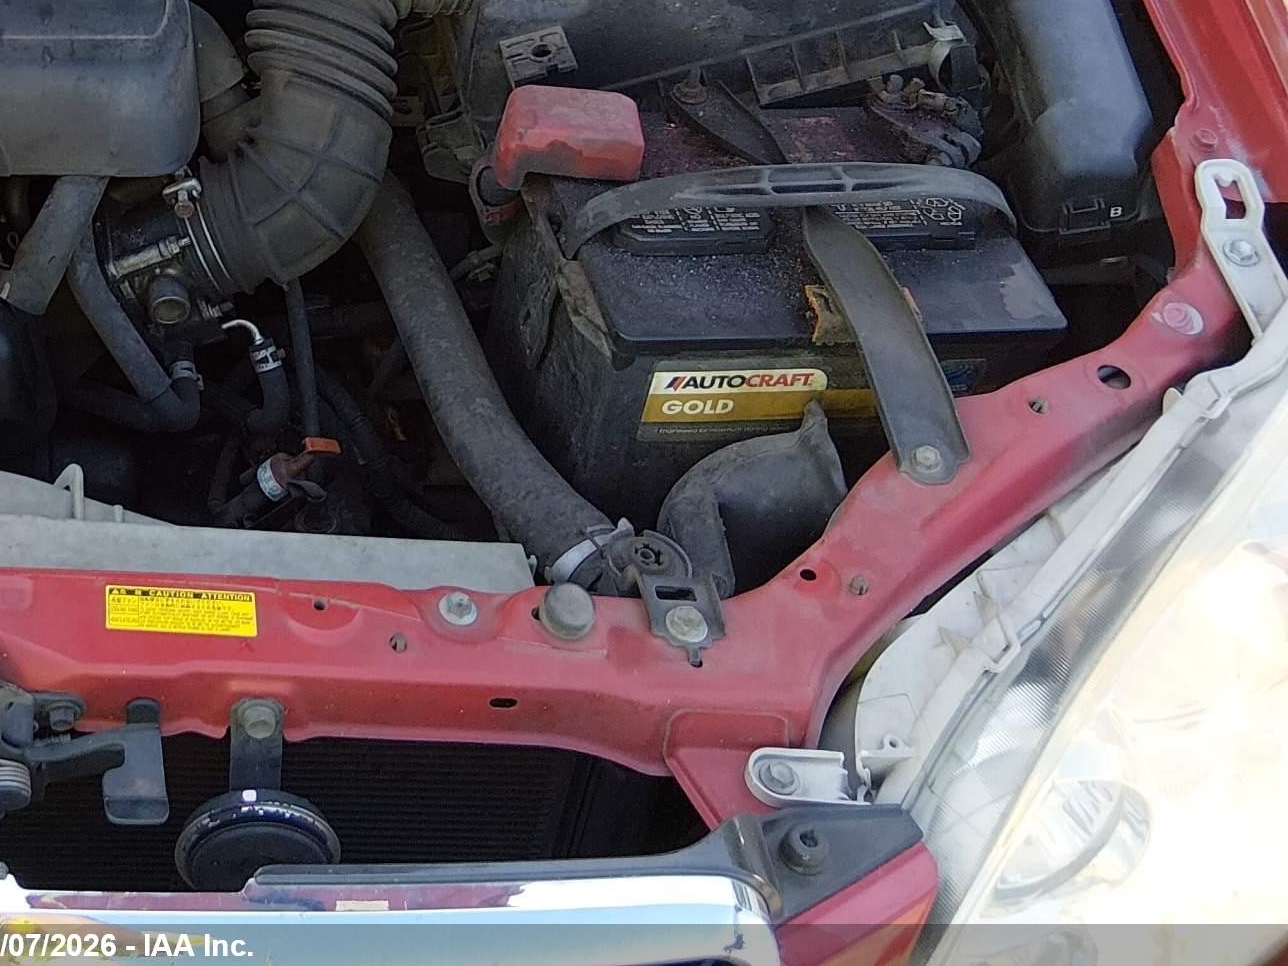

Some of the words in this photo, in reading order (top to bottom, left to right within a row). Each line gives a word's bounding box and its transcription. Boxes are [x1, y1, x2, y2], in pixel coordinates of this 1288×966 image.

[681, 372, 815, 390] AUTOCRAFT
[662, 399, 735, 415] GOLD
[149, 589, 194, 599] CAUTION
[201, 592, 250, 602] ATTENTION
